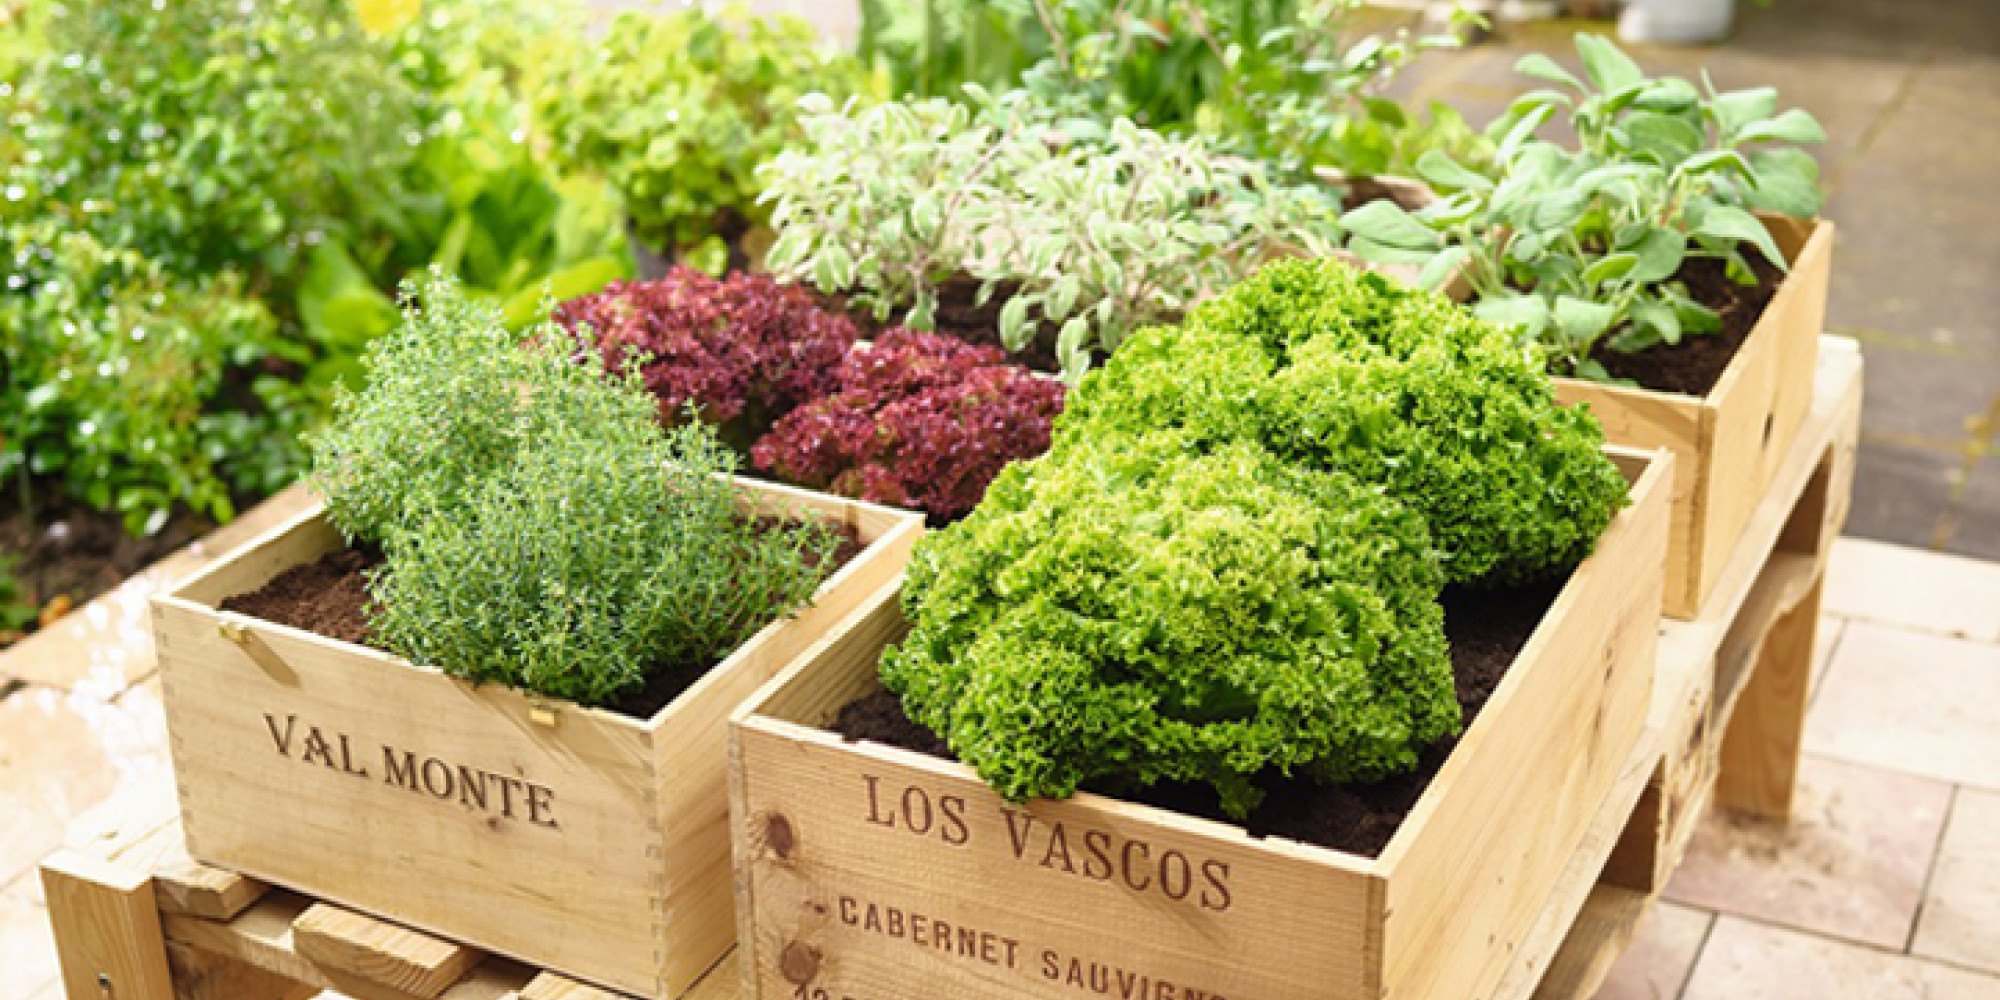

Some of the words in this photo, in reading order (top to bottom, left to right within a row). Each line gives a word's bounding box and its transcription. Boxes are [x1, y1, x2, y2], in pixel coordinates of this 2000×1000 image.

[263, 713, 369, 778] VAL
[382, 745, 560, 829] MONTE
[862, 774, 971, 847] LOS
[1001, 806, 1234, 912] VASCOS
[838, 896, 1020, 970] CABERNET
[1040, 949, 1228, 1000] SAUVIG
